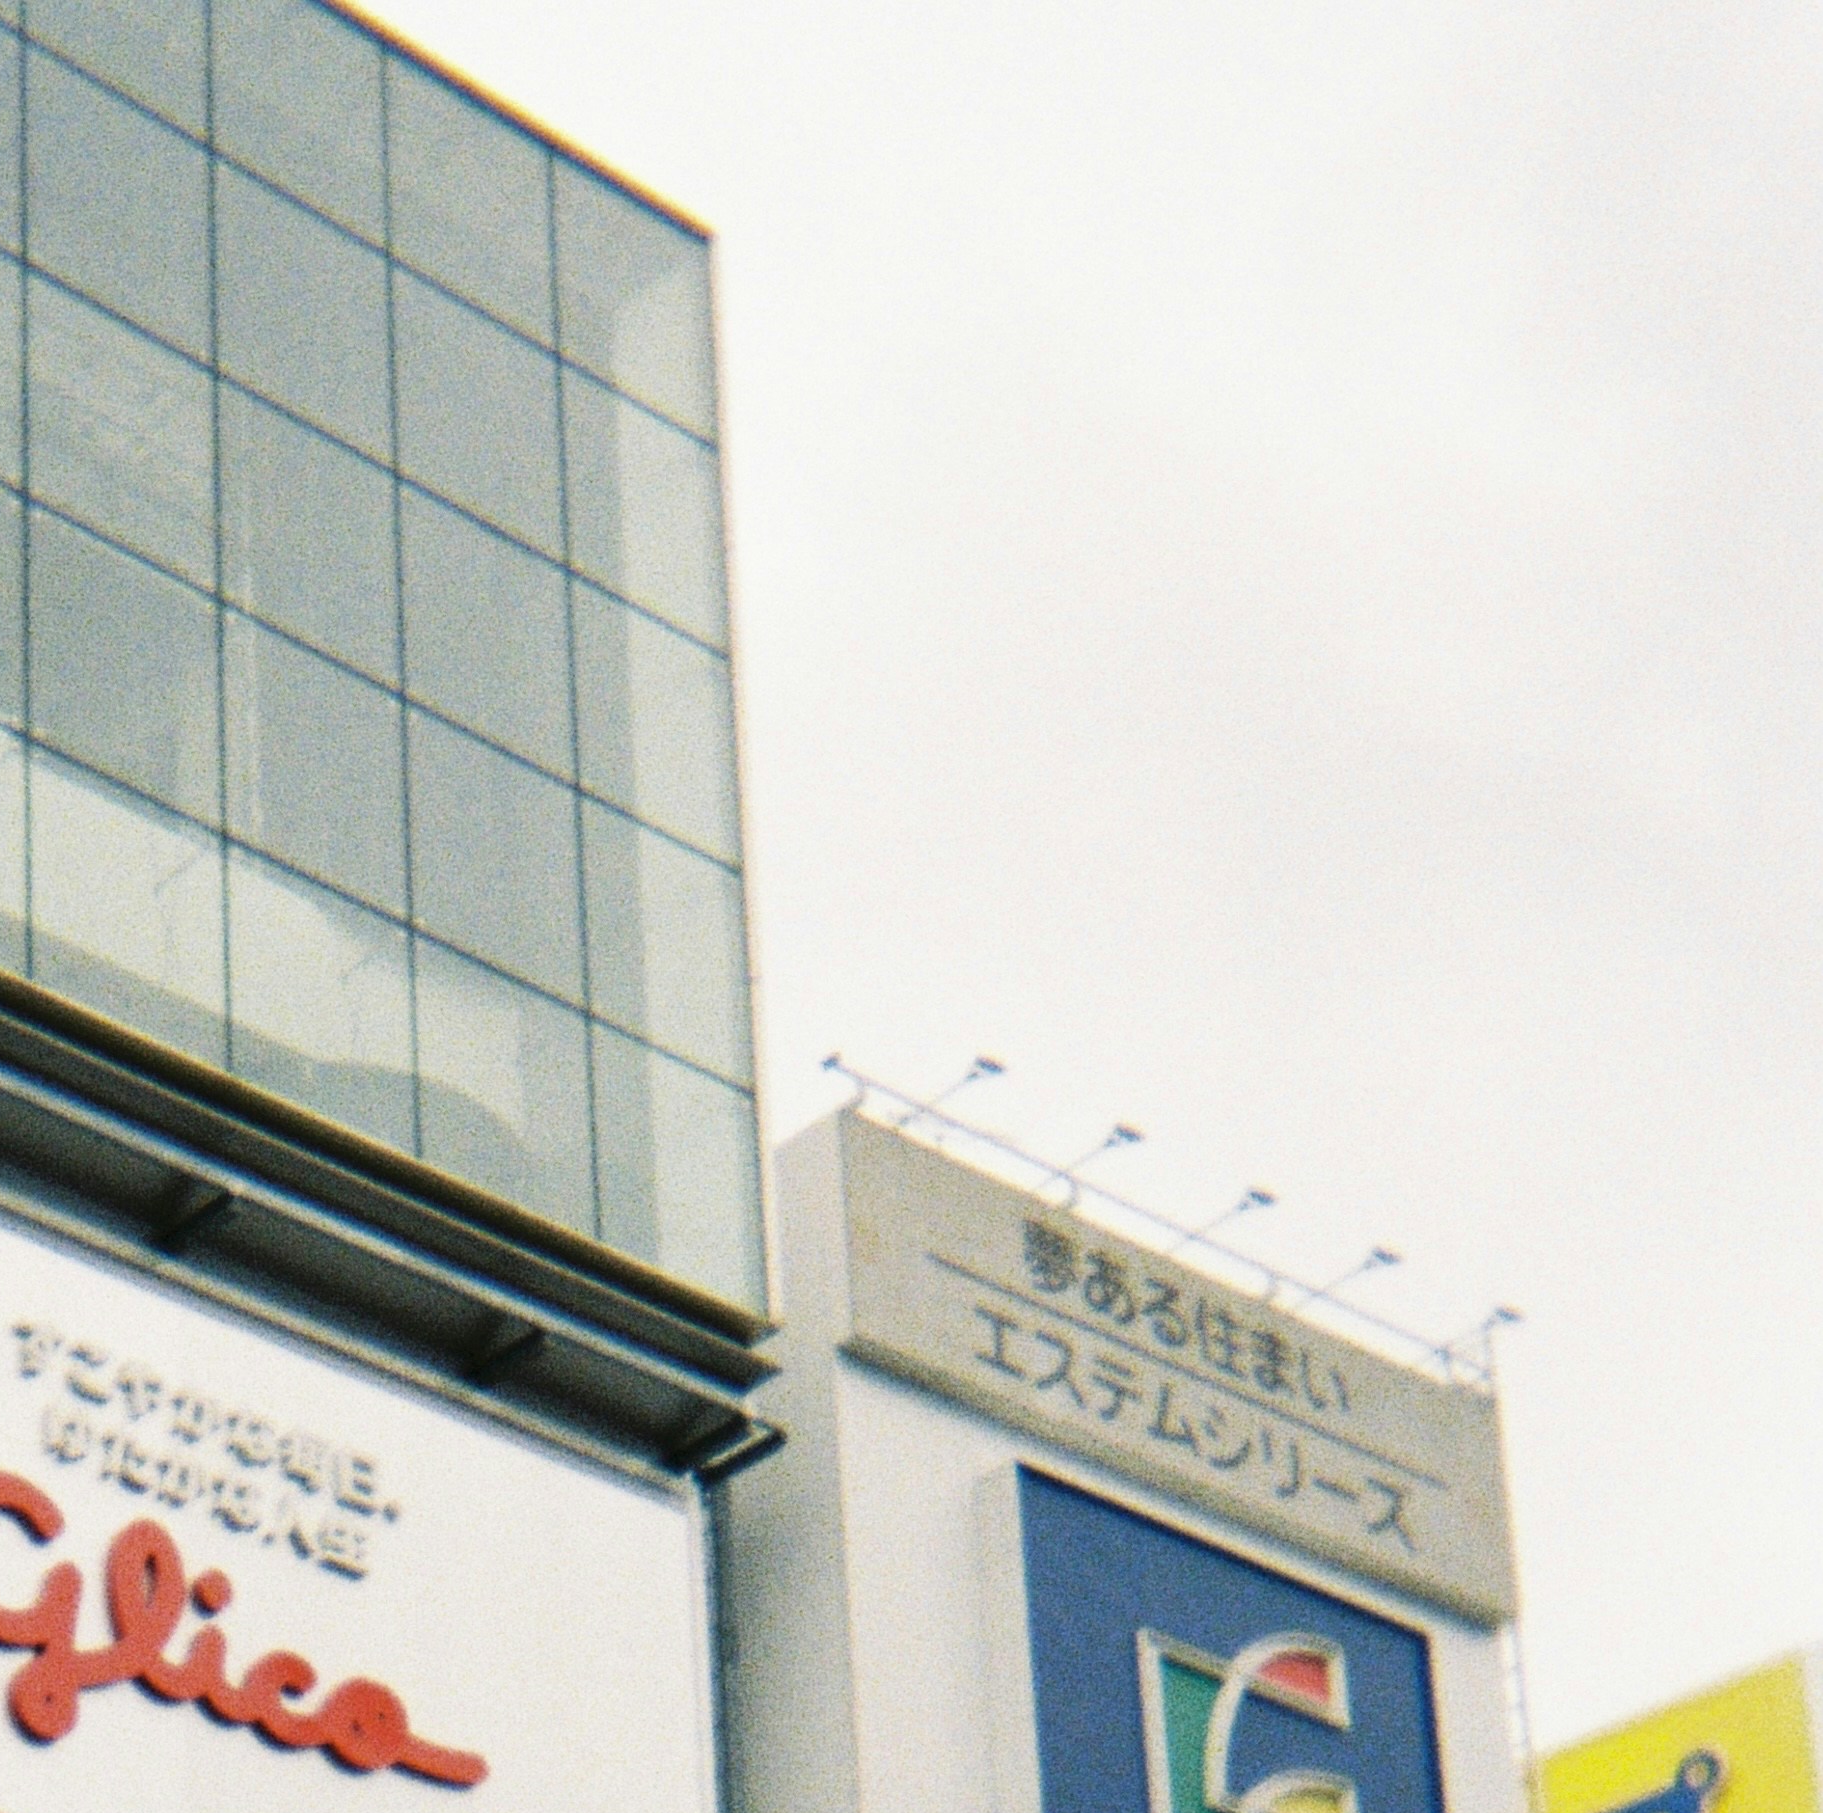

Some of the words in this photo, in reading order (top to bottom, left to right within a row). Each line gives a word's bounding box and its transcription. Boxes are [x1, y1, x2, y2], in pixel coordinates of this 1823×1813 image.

[1022, 1218, 1352, 1414] 夢ある住まい
